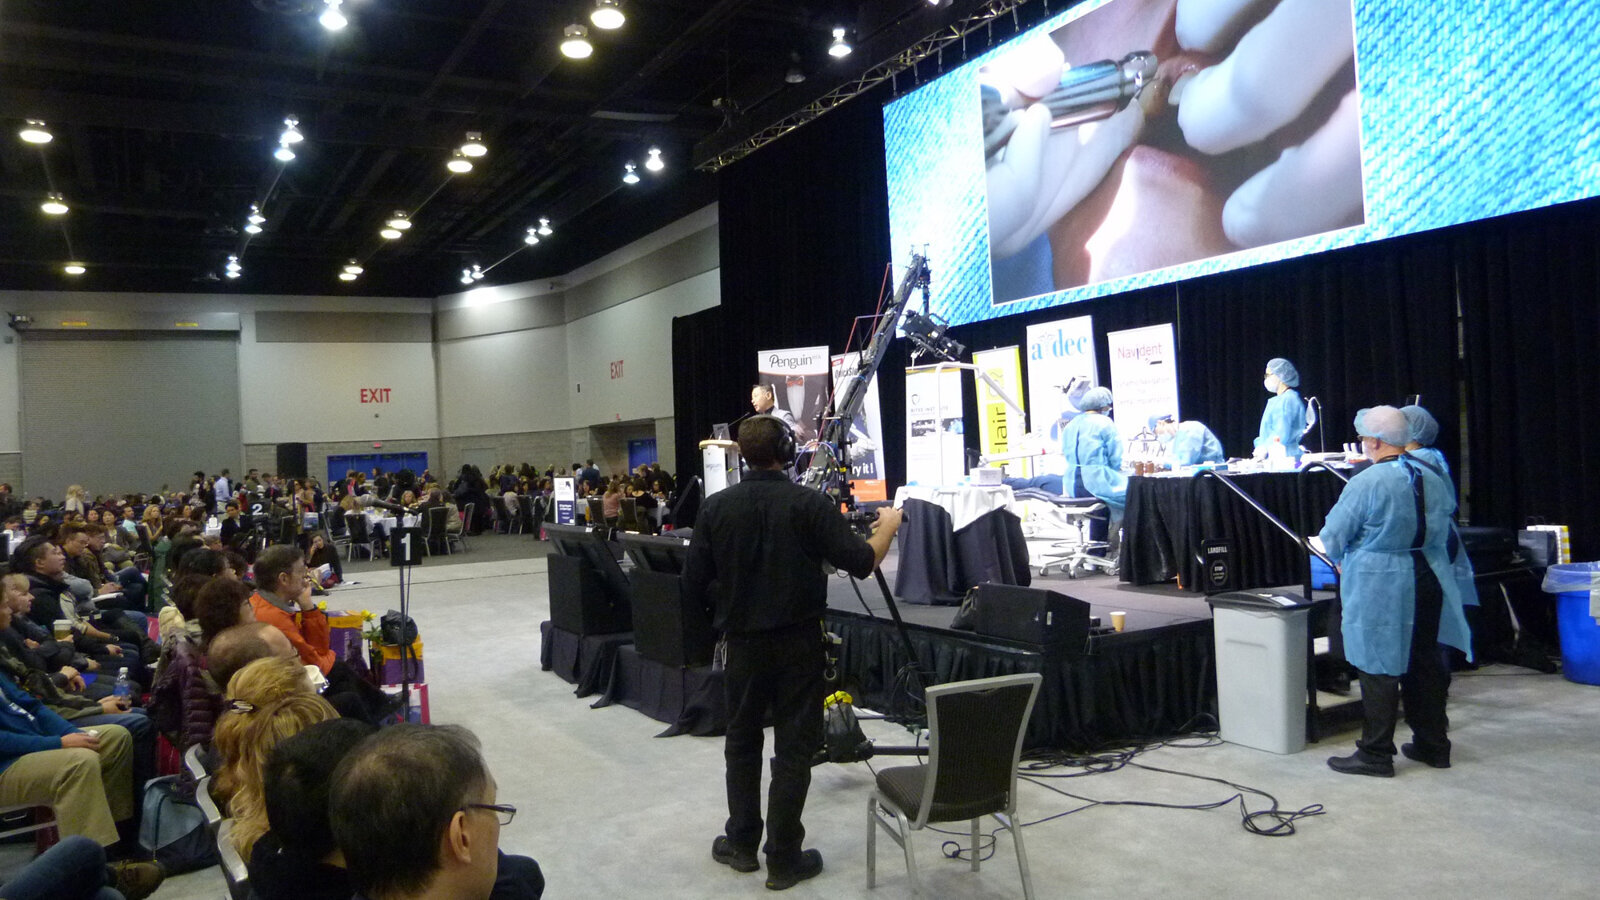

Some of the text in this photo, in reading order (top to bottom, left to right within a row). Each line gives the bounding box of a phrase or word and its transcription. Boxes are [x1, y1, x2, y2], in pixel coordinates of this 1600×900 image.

[1117, 343, 1162, 360] Navident
[610, 360, 624, 379] EXIT
[769, 354, 812, 370] Penguin
[360, 388, 391, 404] EXIT
[252, 503, 263, 516] 2
[401, 533, 411, 561] 1
[1207, 546, 1228, 554] LANDFILL
